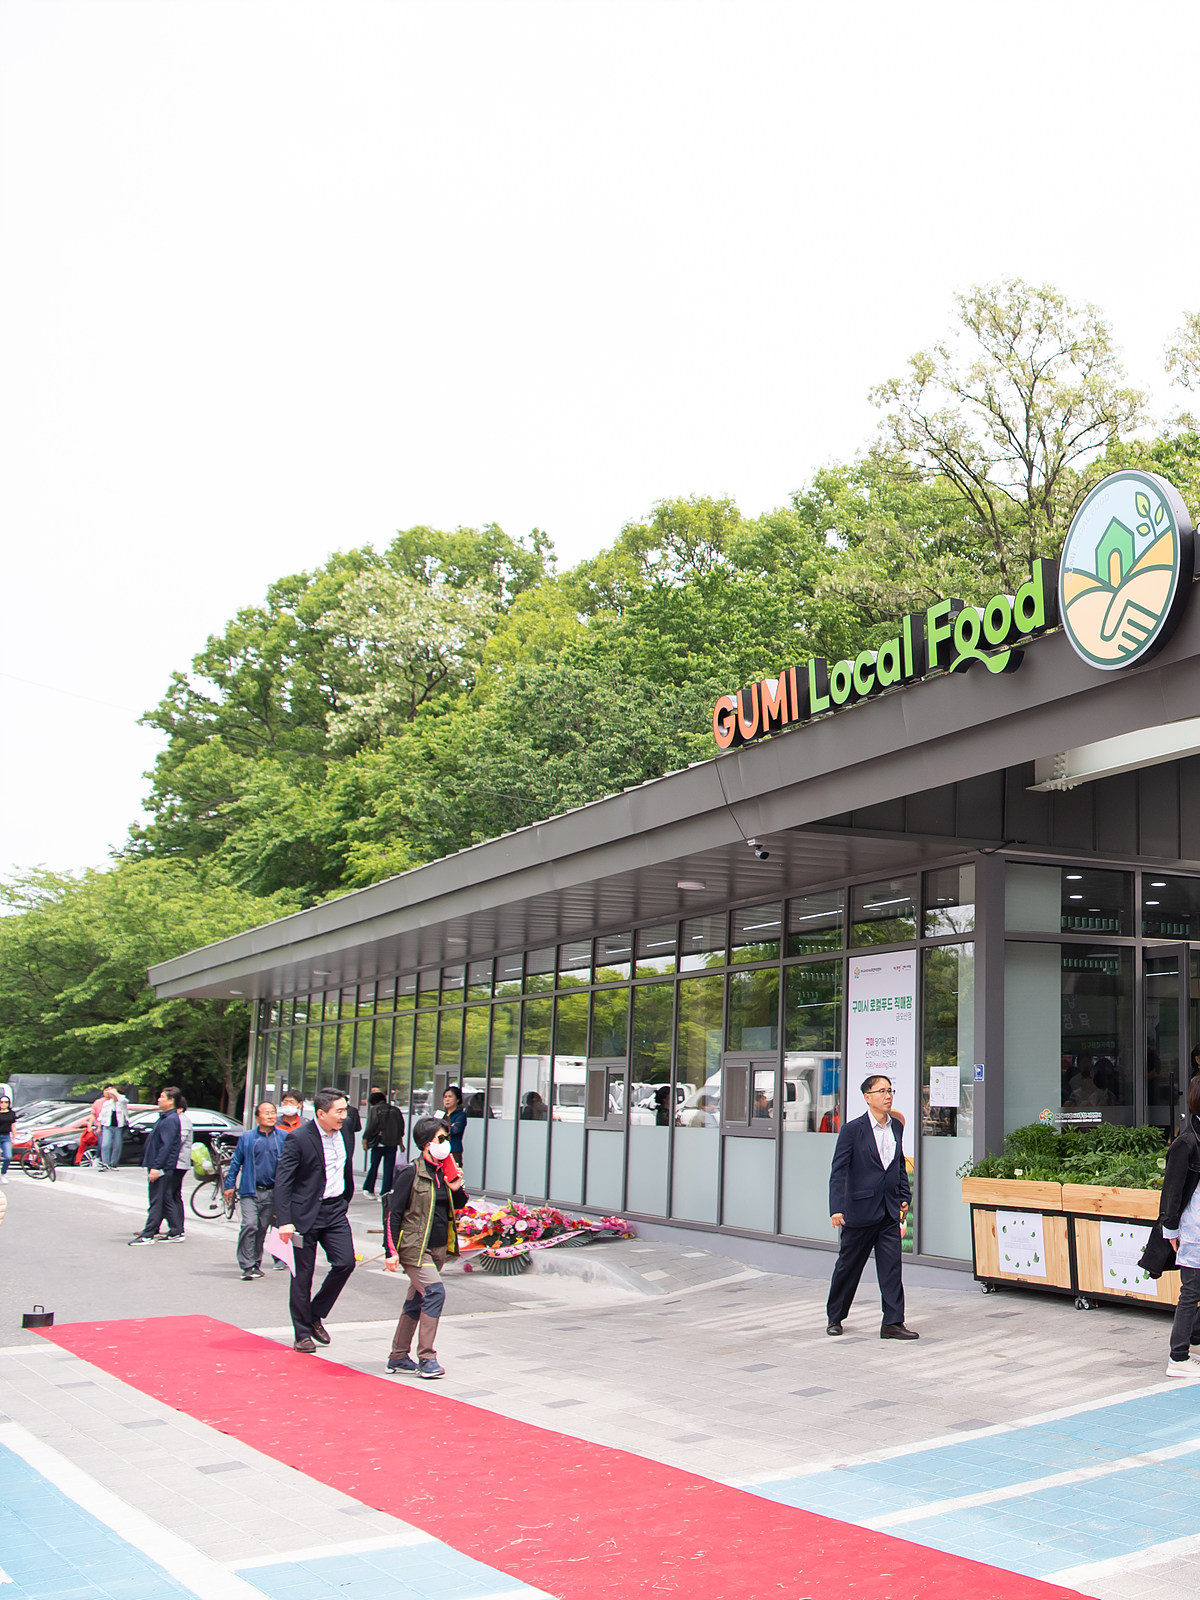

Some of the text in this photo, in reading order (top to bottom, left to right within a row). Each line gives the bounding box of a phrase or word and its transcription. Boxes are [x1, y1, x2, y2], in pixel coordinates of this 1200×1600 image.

[713, 557, 1047, 749] GUMI Local Food
[852, 996, 912, 1013] 구미시 로컬푸드 직매장
